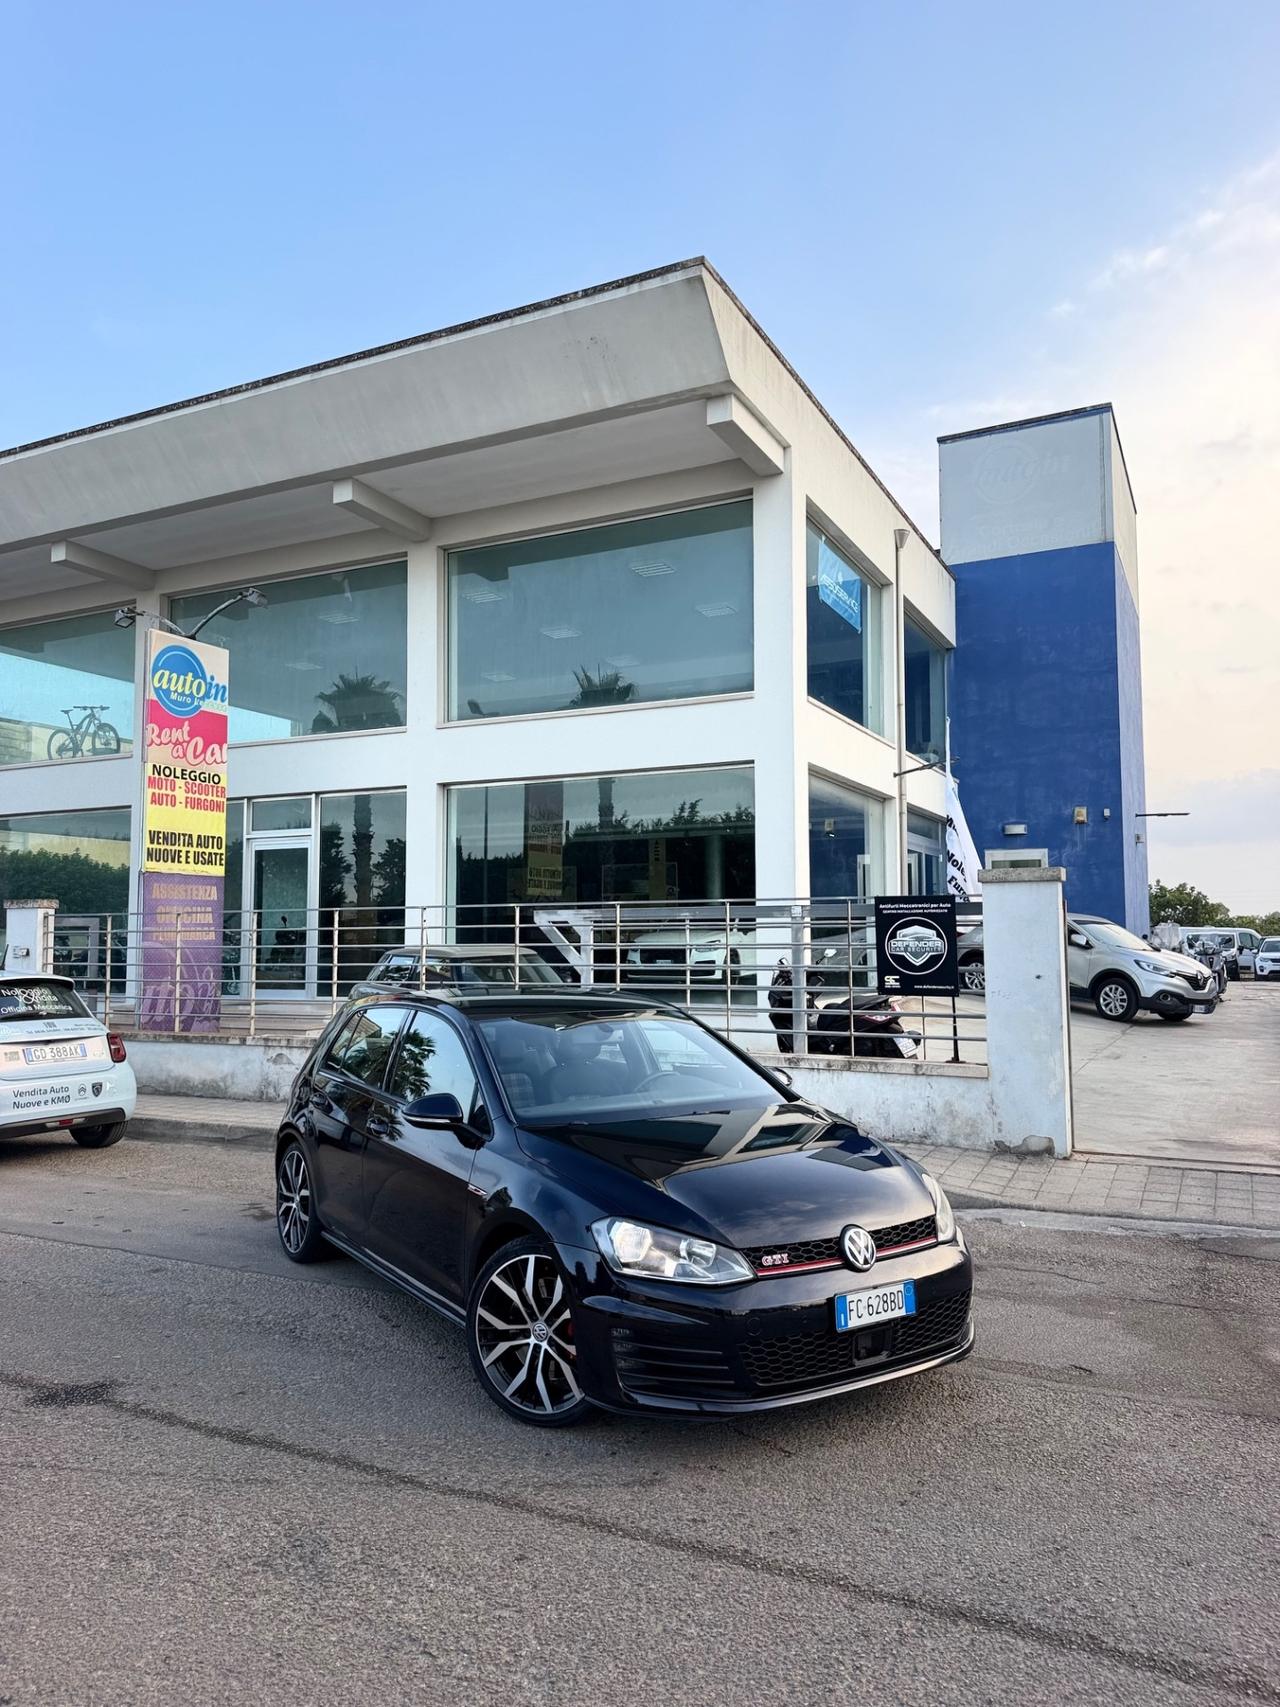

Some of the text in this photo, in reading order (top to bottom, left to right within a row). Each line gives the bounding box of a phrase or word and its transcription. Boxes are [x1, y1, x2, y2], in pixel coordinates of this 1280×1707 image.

[170, 691, 192, 704] Muro
[146, 720, 190, 746] Rent
[152, 764, 221, 785] NOLEGGIO
[147, 775, 177, 792] MOTO
[184, 781, 226, 799] SCOOTER
[150, 792, 177, 808] AUTO
[184, 796, 225, 813] FURGONI
[148, 829, 223, 850] VENDITA AUTO
[146, 847, 224, 866] NUOVE E USATE
[151, 883, 218, 901] ASSISTENZA
[0, 1005, 33, 1014] Officina
[49, 1045, 80, 1058] 388AK
[12, 1086, 70, 1098] Vendita Auto
[12, 1100, 42, 1109] Nuove
[761, 1253, 790, 1266] GTI
[848, 1300, 864, 1321] FC
[867, 1289, 904, 1317] 628BD
